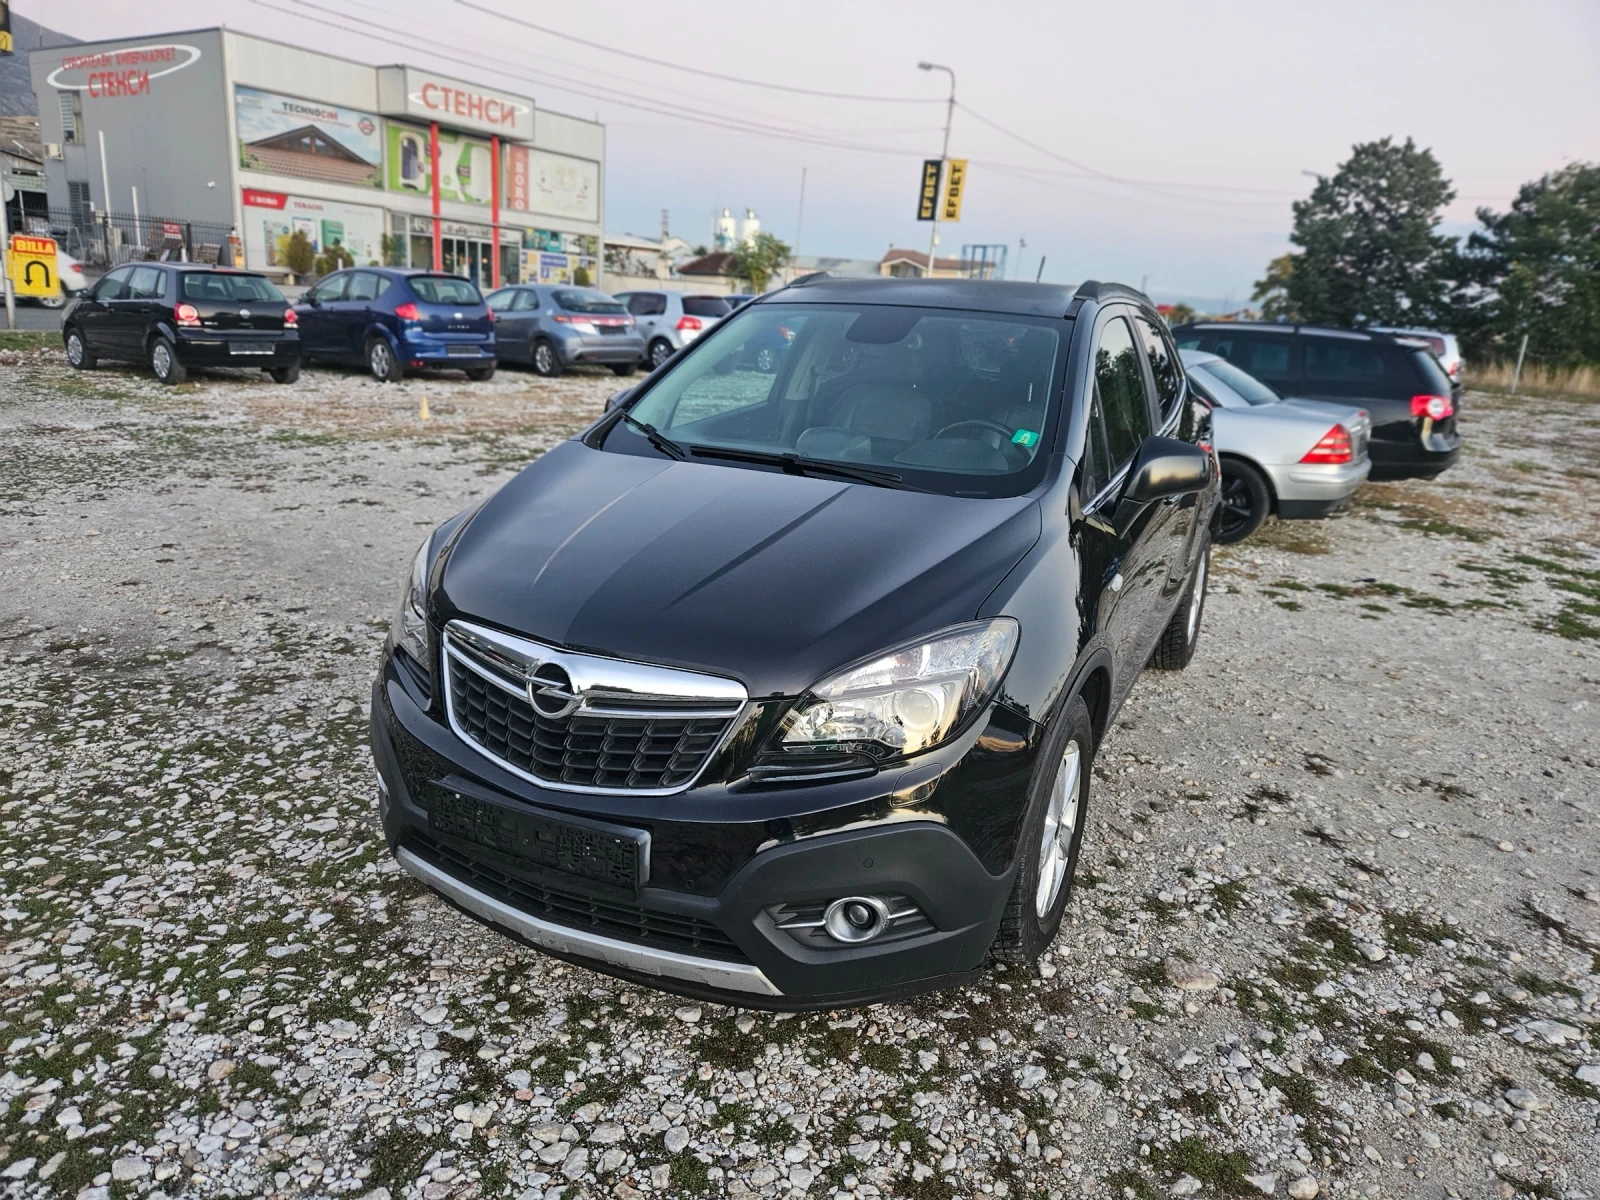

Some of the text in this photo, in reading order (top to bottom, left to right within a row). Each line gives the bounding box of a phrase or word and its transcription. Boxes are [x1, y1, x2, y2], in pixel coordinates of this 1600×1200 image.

[88, 69, 151, 98] СТЕНСИ
[281, 101, 339, 120] TECHNOCIM
[421, 82, 516, 128] СТЕНСИ
[921, 163, 938, 218] EFBET
[946, 163, 963, 218] EFBET
[15, 239, 55, 254] BILLA
